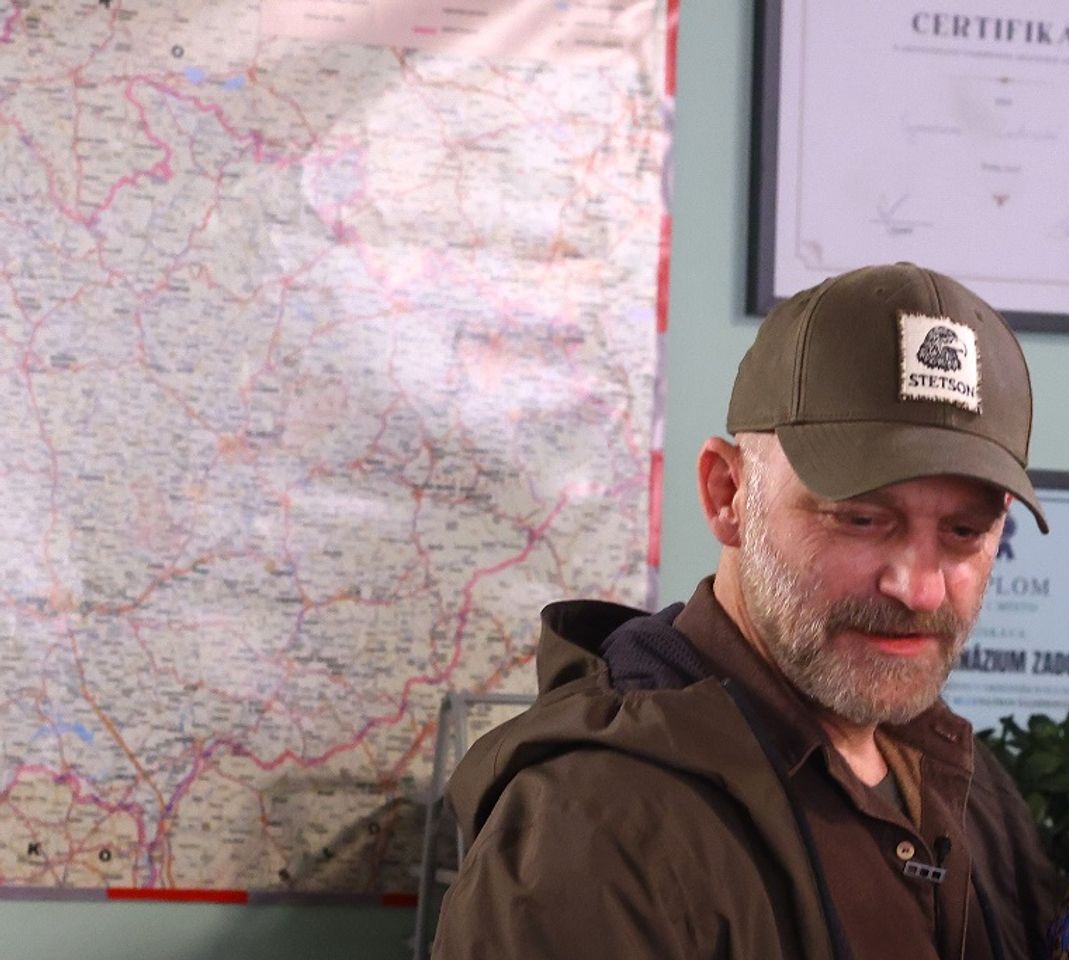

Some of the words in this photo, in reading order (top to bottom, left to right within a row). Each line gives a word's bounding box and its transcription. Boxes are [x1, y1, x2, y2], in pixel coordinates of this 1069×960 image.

[908, 373, 975, 398] STETSON
[988, 575, 1050, 598] LOM
[959, 642, 1026, 673] NÁZIUM
